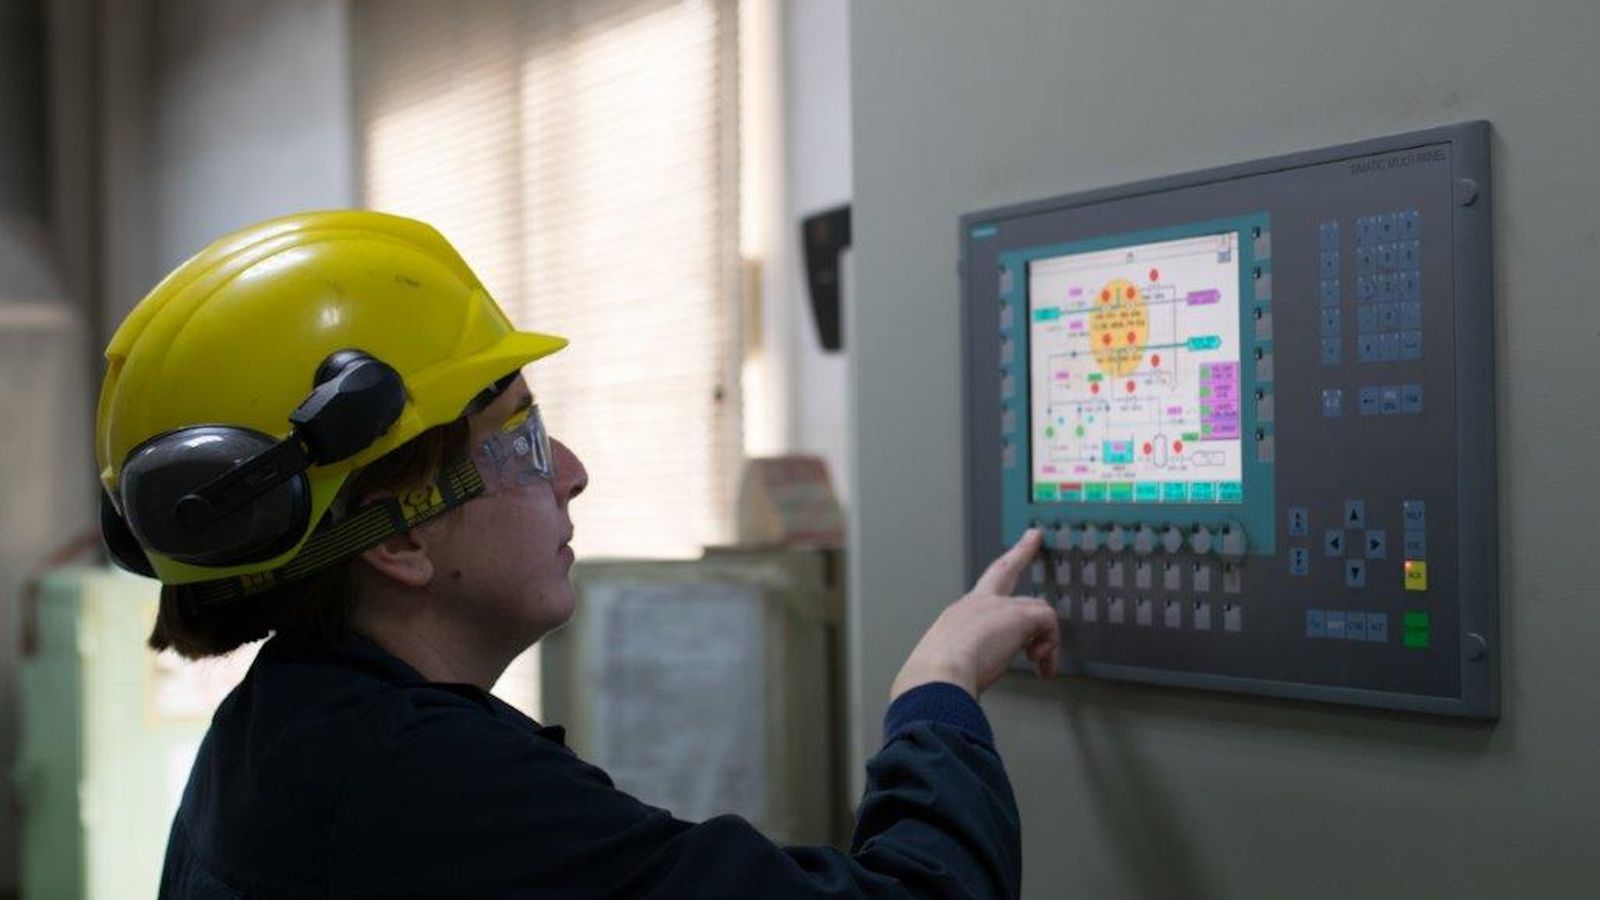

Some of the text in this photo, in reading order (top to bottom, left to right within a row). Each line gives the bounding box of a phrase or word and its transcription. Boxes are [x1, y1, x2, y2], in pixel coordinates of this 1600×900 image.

[1351, 149, 1447, 173] SIMATIC MULTI PANEL
